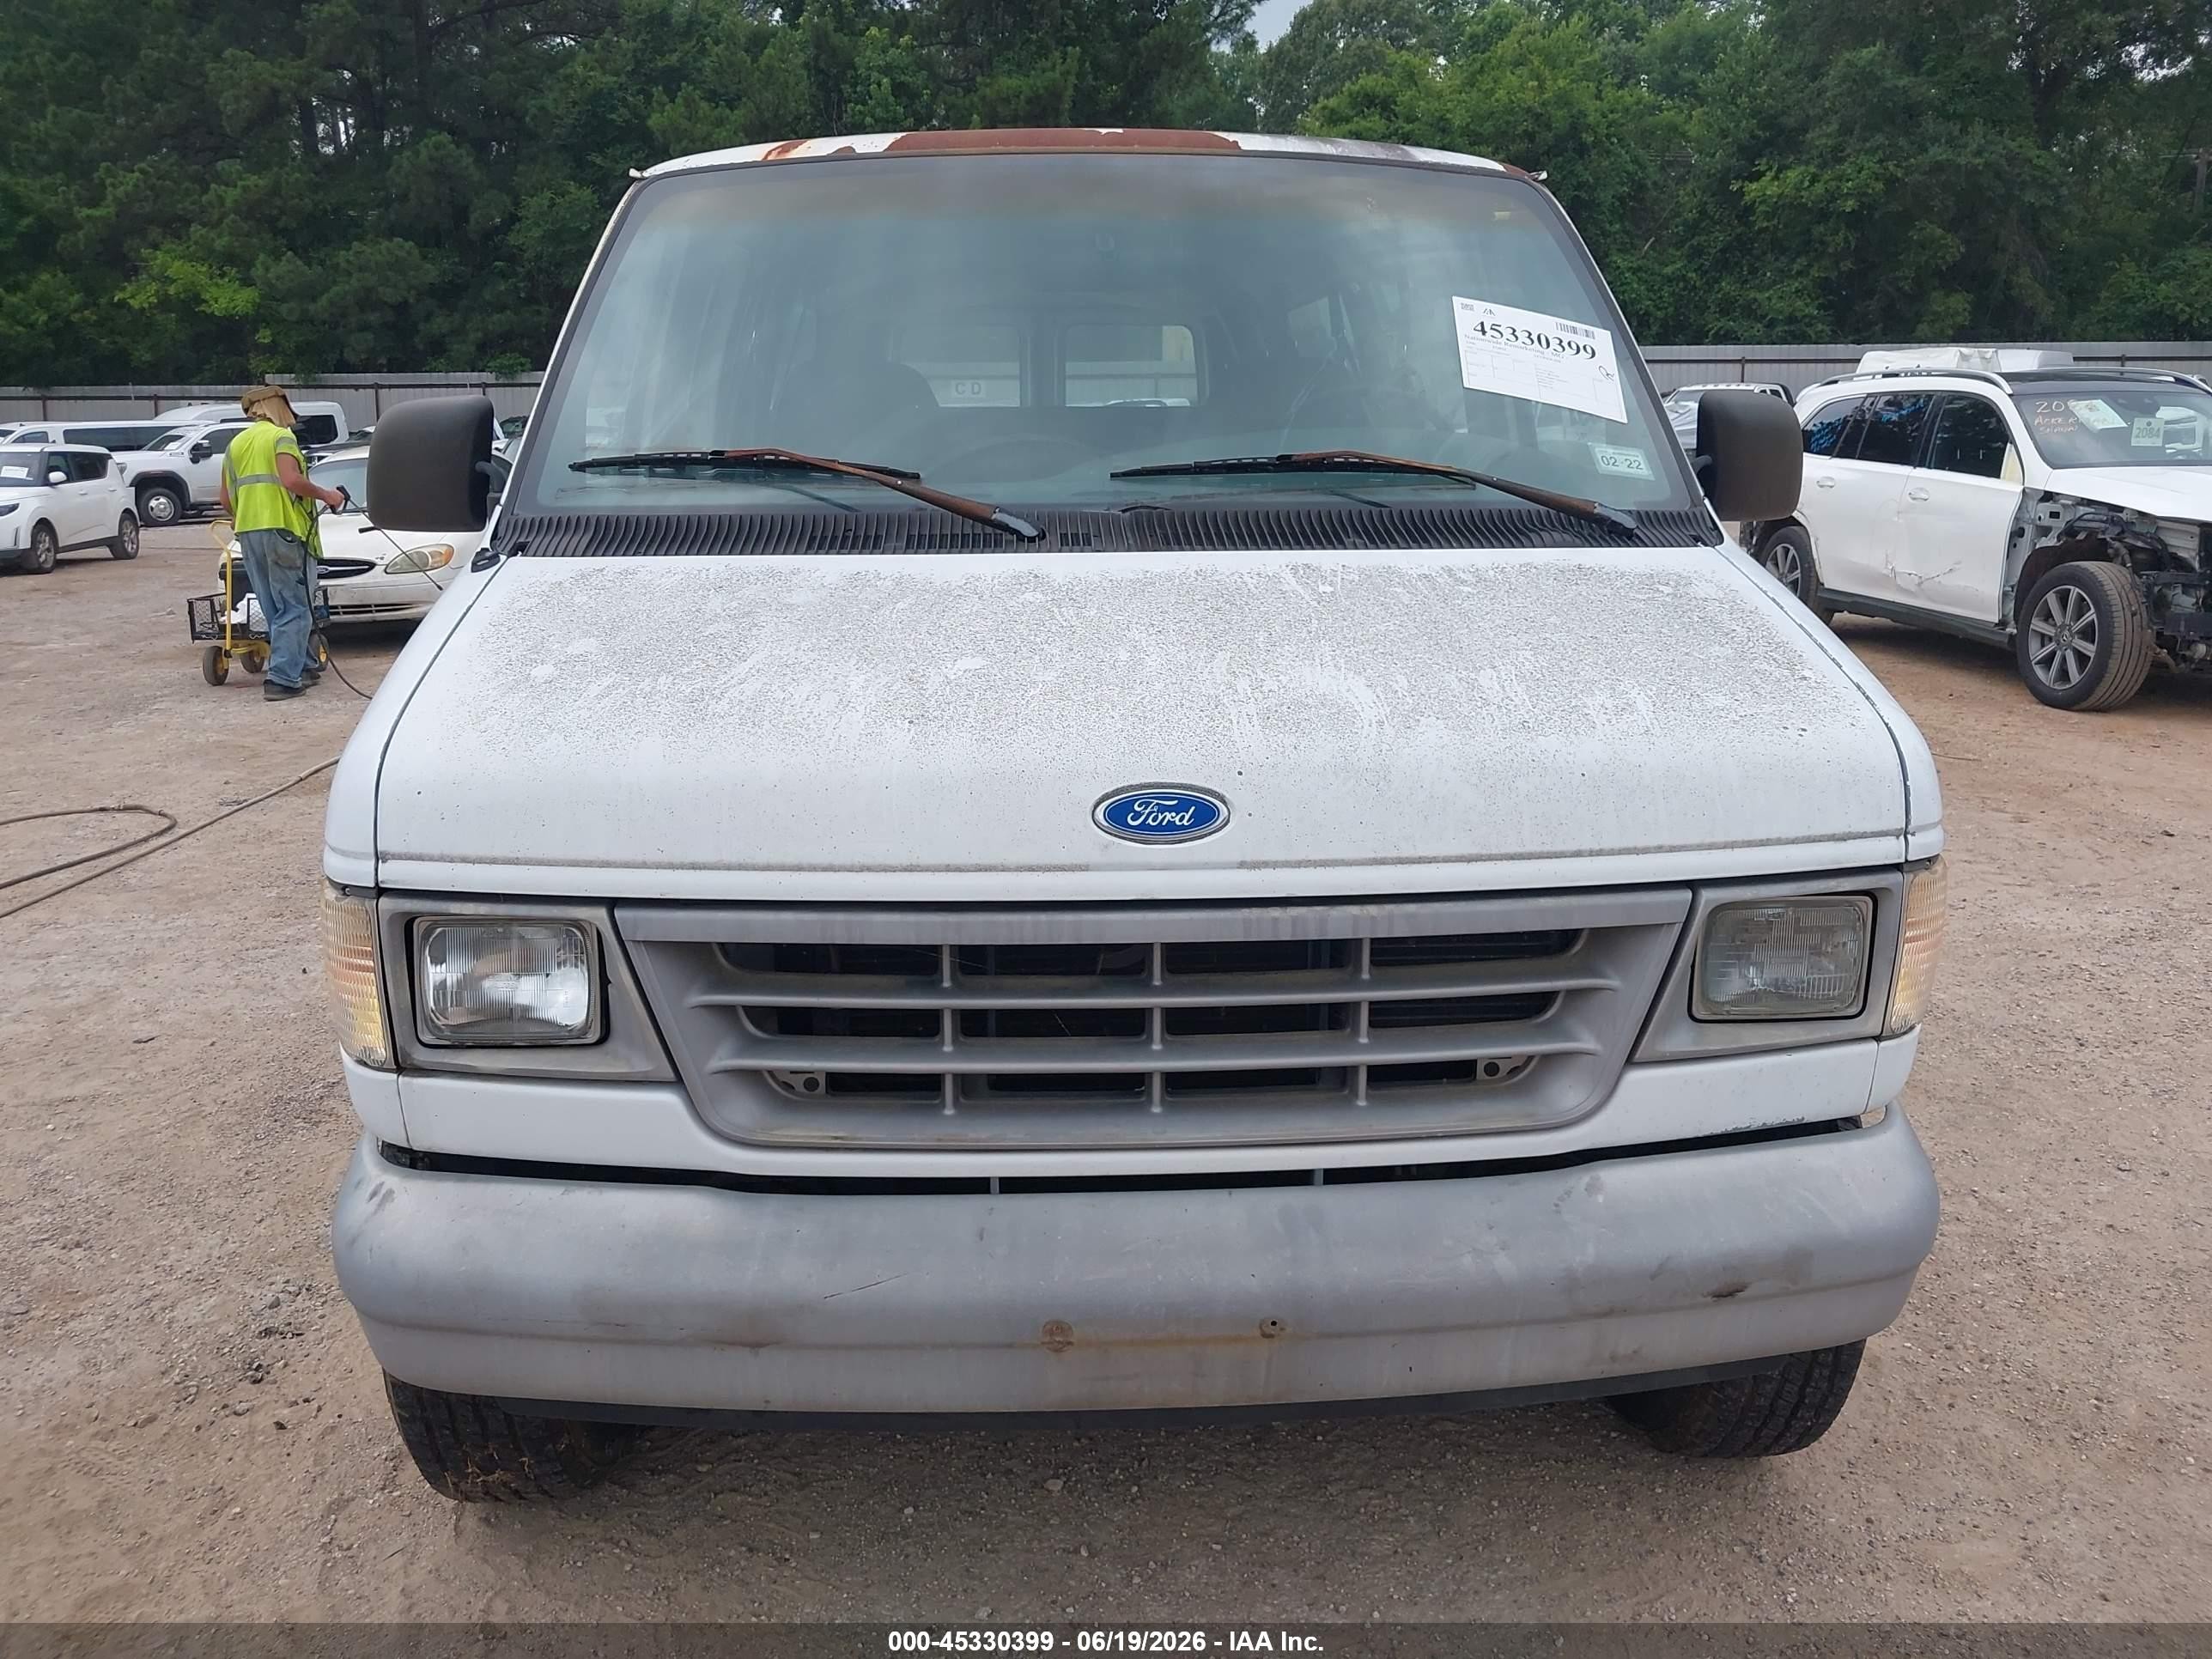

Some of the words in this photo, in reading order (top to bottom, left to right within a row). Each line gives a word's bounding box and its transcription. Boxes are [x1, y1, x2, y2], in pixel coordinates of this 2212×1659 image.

[1473, 320, 1596, 360] 45330399
[2136, 427, 2160, 439] 2084
[1127, 799, 1196, 826] Ford
